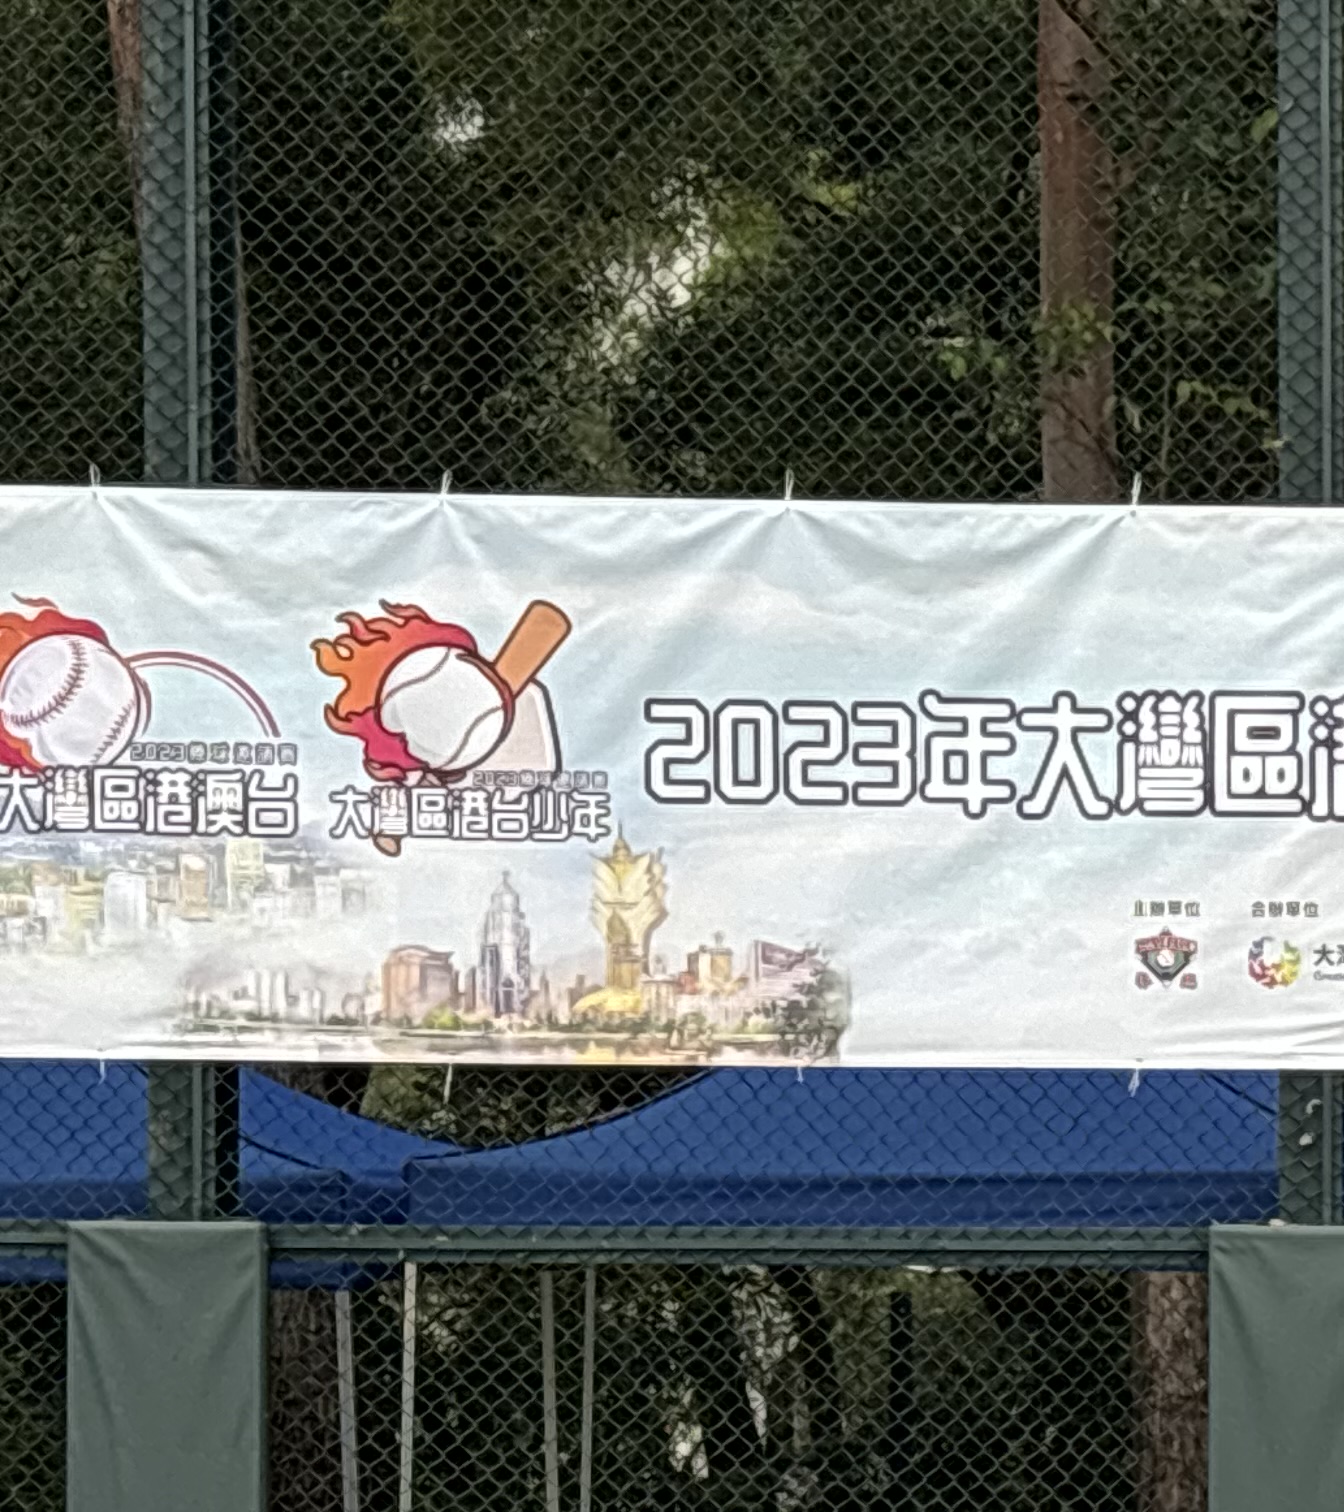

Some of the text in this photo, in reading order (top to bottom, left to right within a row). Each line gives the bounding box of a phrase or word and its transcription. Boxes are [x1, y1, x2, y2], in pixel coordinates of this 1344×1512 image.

[0, 765, 299, 838] 大灣區港澳台
[329, 784, 611, 842] 大灣區港台少年
